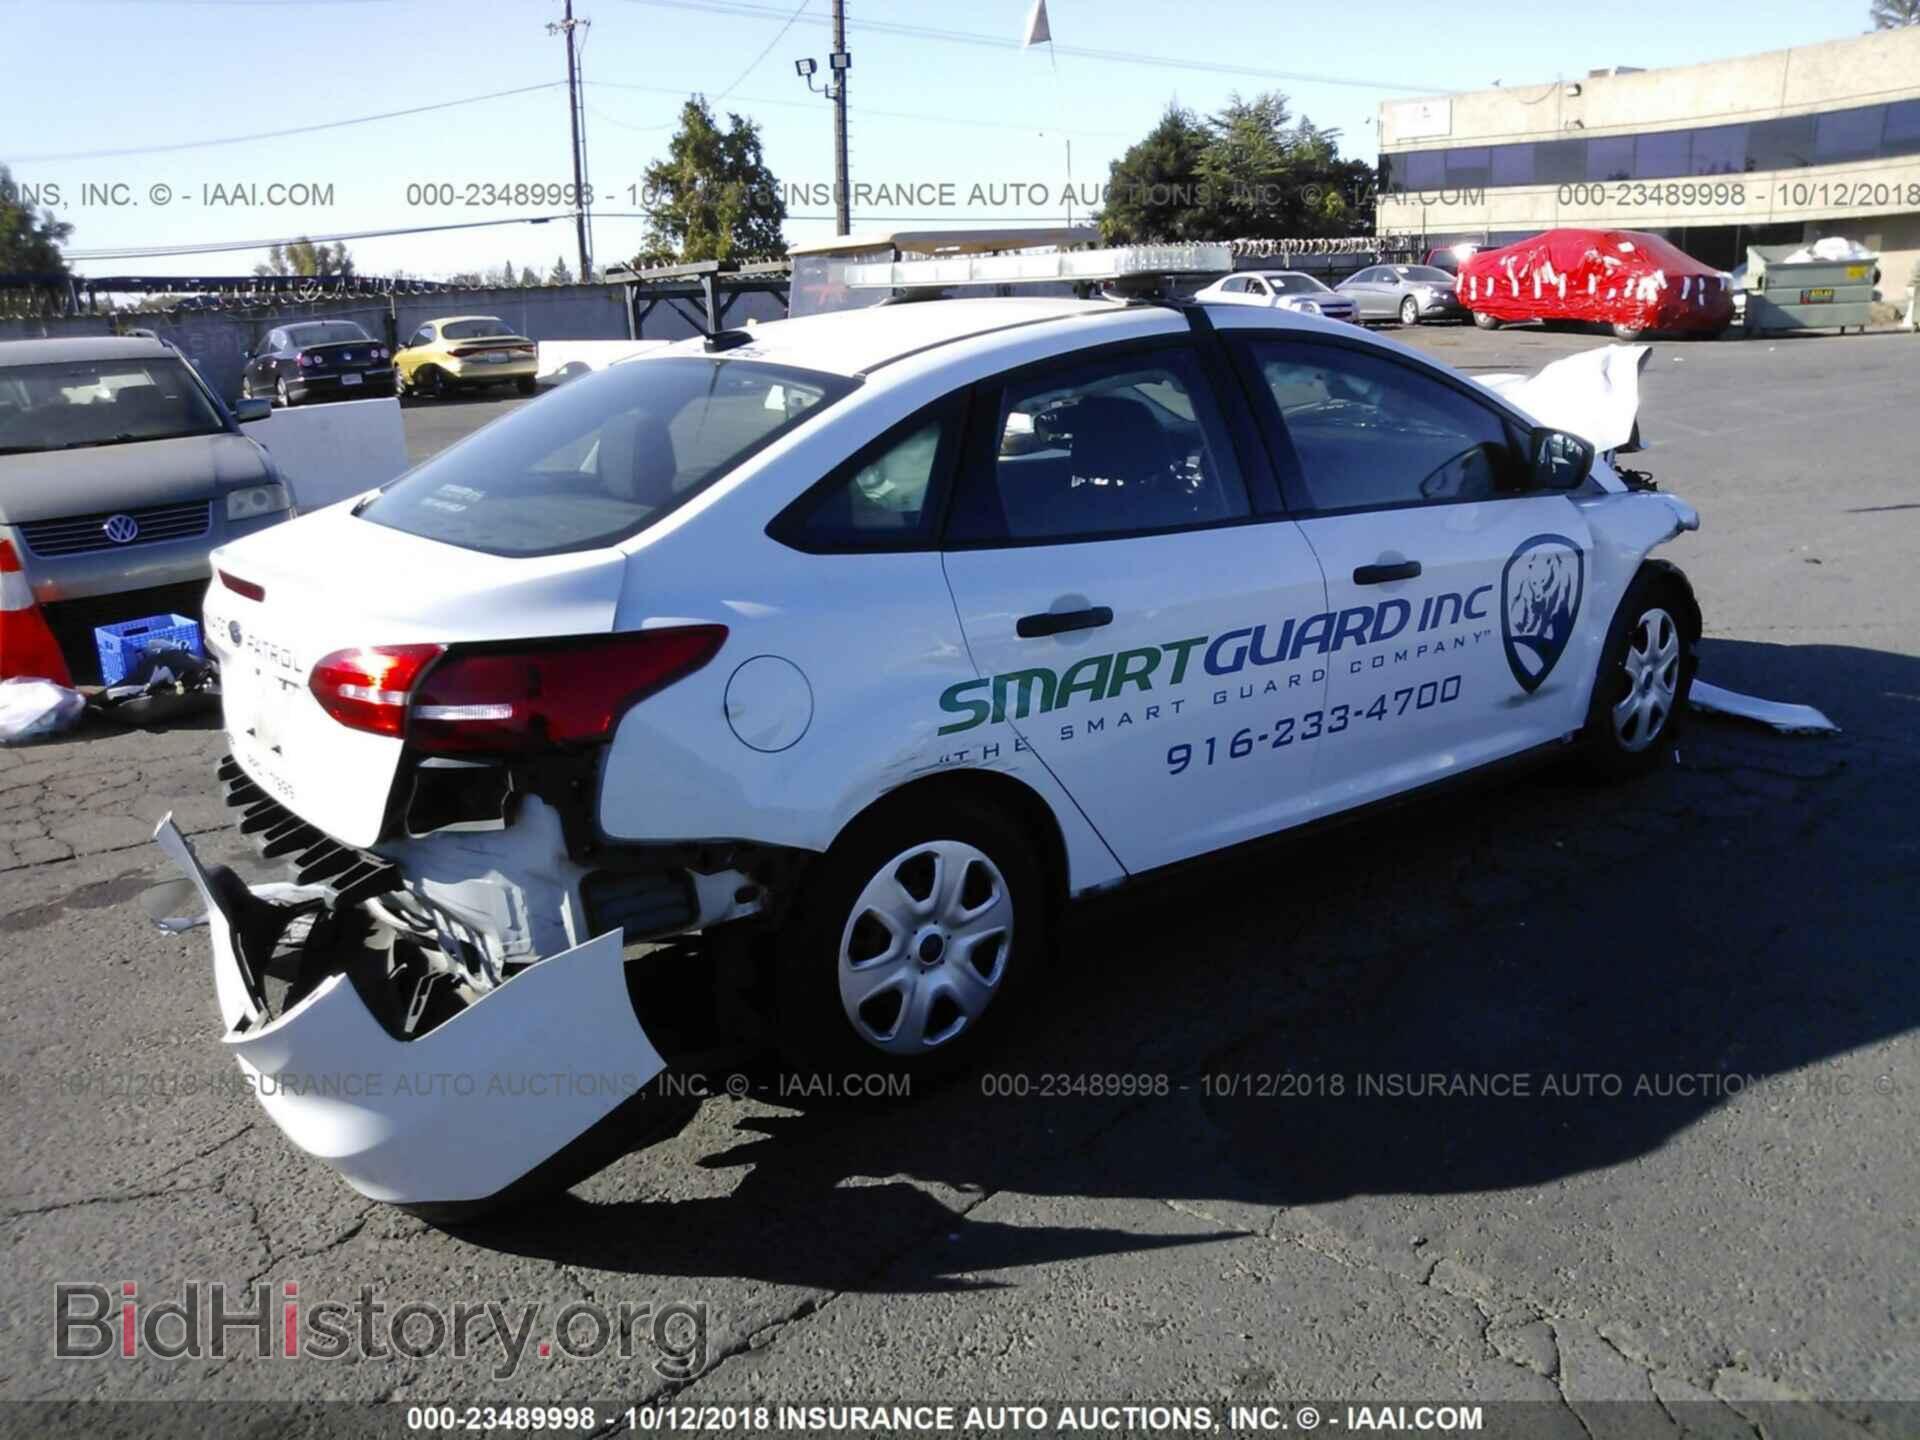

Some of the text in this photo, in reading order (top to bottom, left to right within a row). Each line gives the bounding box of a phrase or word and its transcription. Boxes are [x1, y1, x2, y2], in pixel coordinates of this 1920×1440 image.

[937, 584, 1494, 737] SMARTGUARD INC
[1060, 699, 1185, 741] SMART
[1213, 668, 1326, 705] GUARD
[1166, 675, 1462, 776] 916-233-4700
